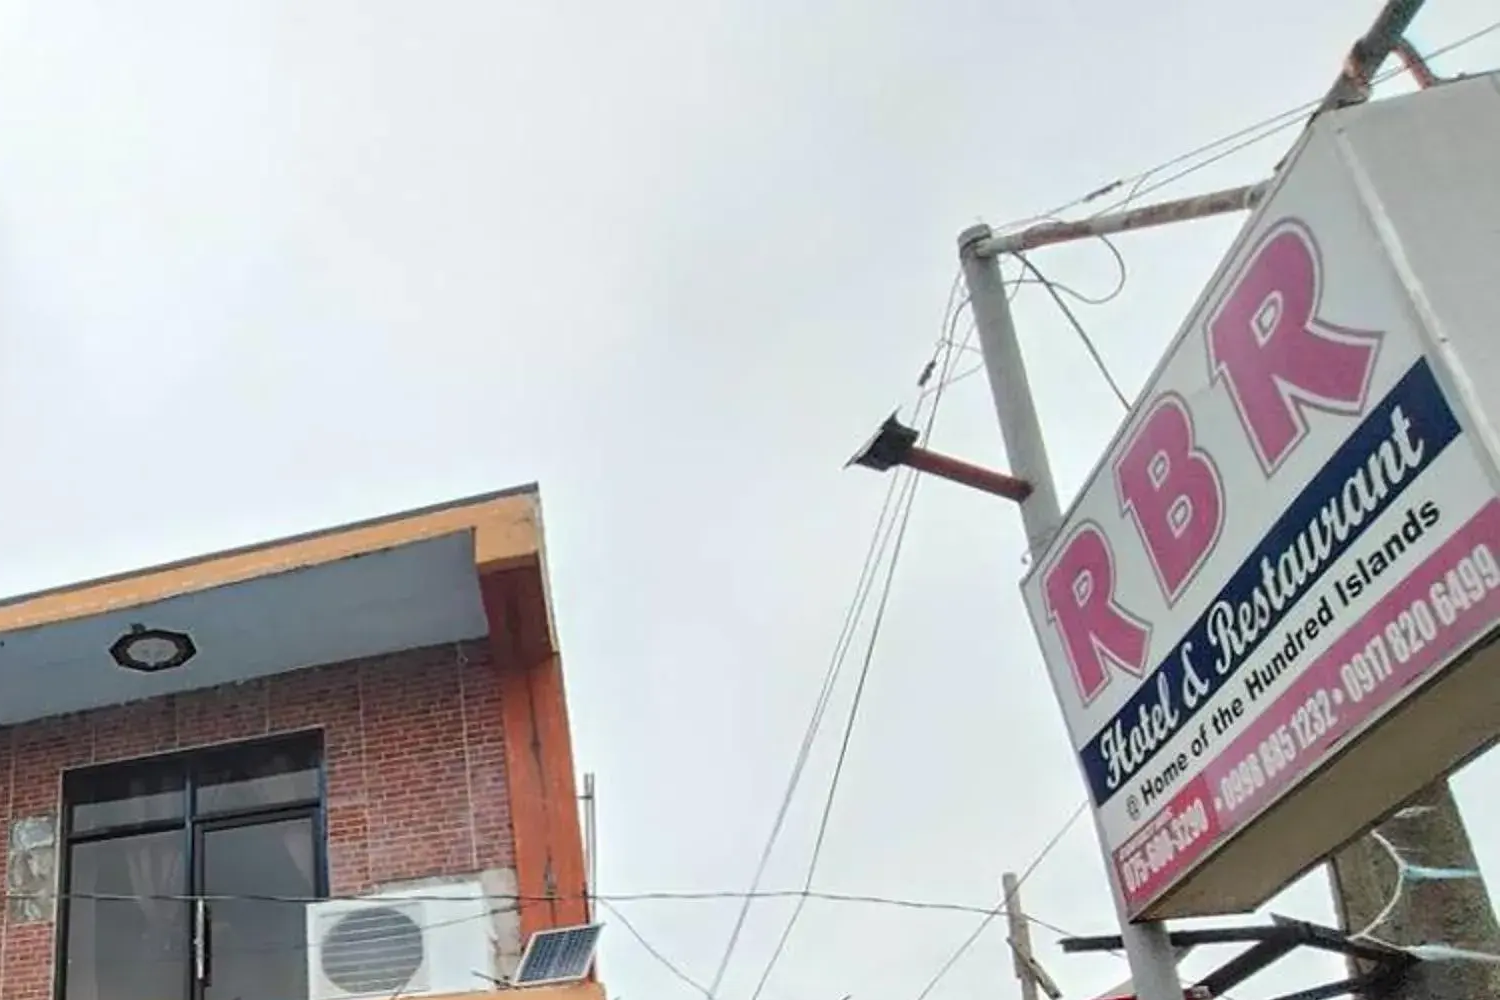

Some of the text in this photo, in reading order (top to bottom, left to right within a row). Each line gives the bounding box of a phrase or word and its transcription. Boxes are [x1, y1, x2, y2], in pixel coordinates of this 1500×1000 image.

[1041, 216, 1386, 707] RBR
[1100, 670, 1180, 790] Hotel
[1182, 641, 1212, 710] &
[1206, 404, 1425, 676] Restaurant
[1140, 752, 1188, 806] Home
[1190, 724, 1209, 757] of
[1211, 697, 1245, 736] the
[1244, 595, 1334, 702] Hundred
[1334, 500, 1440, 607] Islands
[1290, 688, 1338, 750] 1232
[1340, 633, 1393, 703] 0917
[1384, 598, 1438, 664] 820
[1429, 542, 1500, 626] 6499
